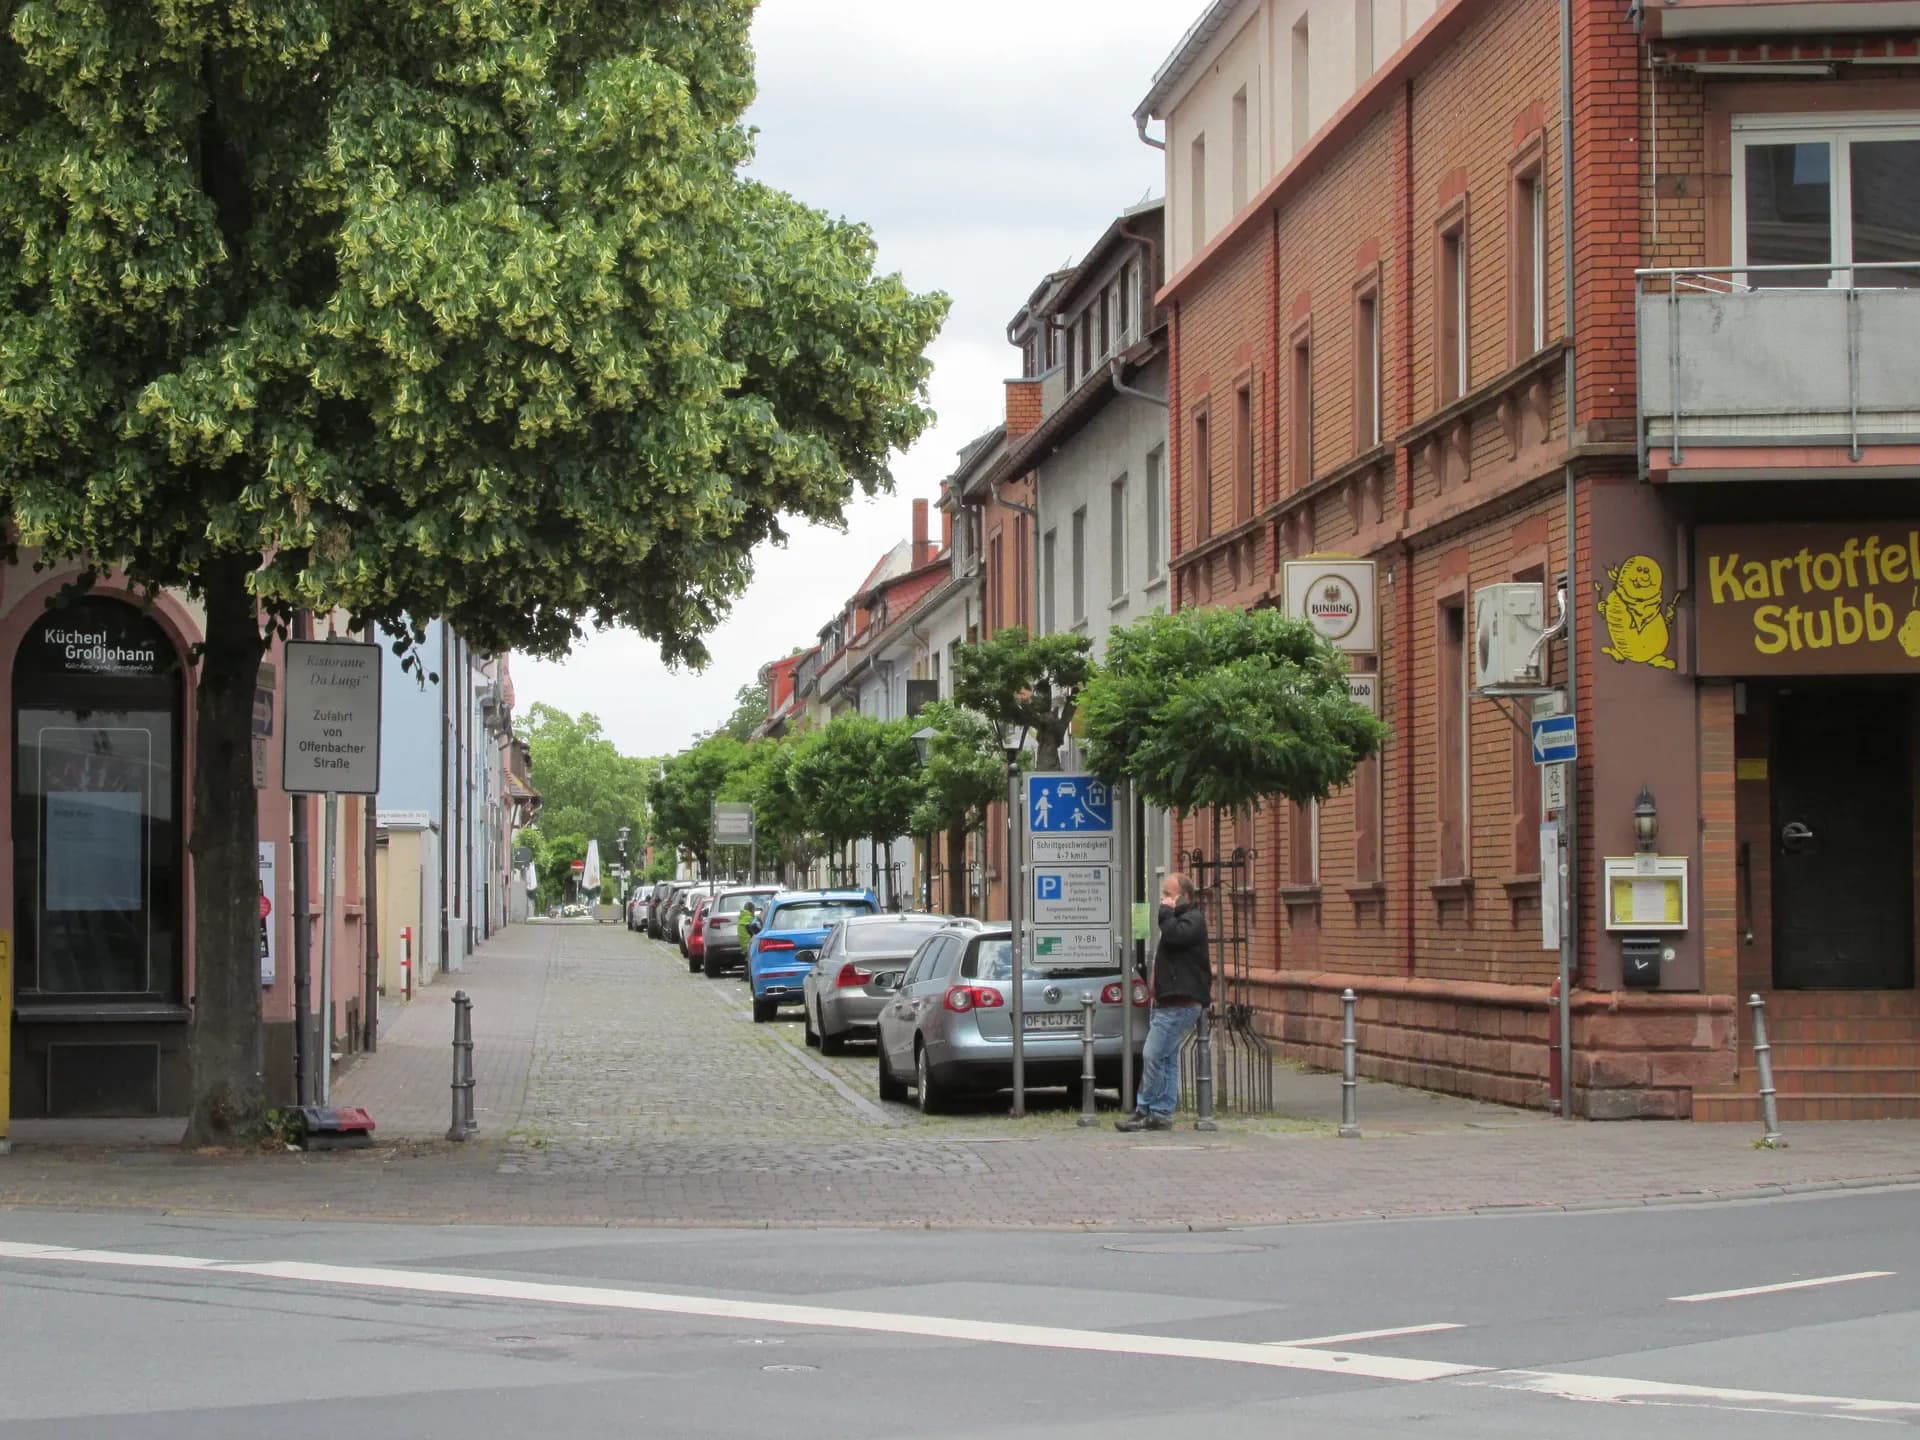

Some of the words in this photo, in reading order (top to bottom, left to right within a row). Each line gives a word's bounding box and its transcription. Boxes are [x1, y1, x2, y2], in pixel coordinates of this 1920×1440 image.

[1708, 531, 1920, 604] Kartoffel
[1312, 603, 1353, 614] BINDING
[1753, 592, 1895, 655] Stubb
[44, 629, 107, 647] Küchen!
[65, 645, 155, 664] Großjohann
[313, 709, 353, 721] Zufahrt
[323, 728, 343, 737] von
[298, 740, 366, 754] Offenbacher
[313, 757, 350, 769] Straße
[1036, 839, 1108, 850] Schrittgeschwindigkeit
[1042, 878, 1057, 897] P
